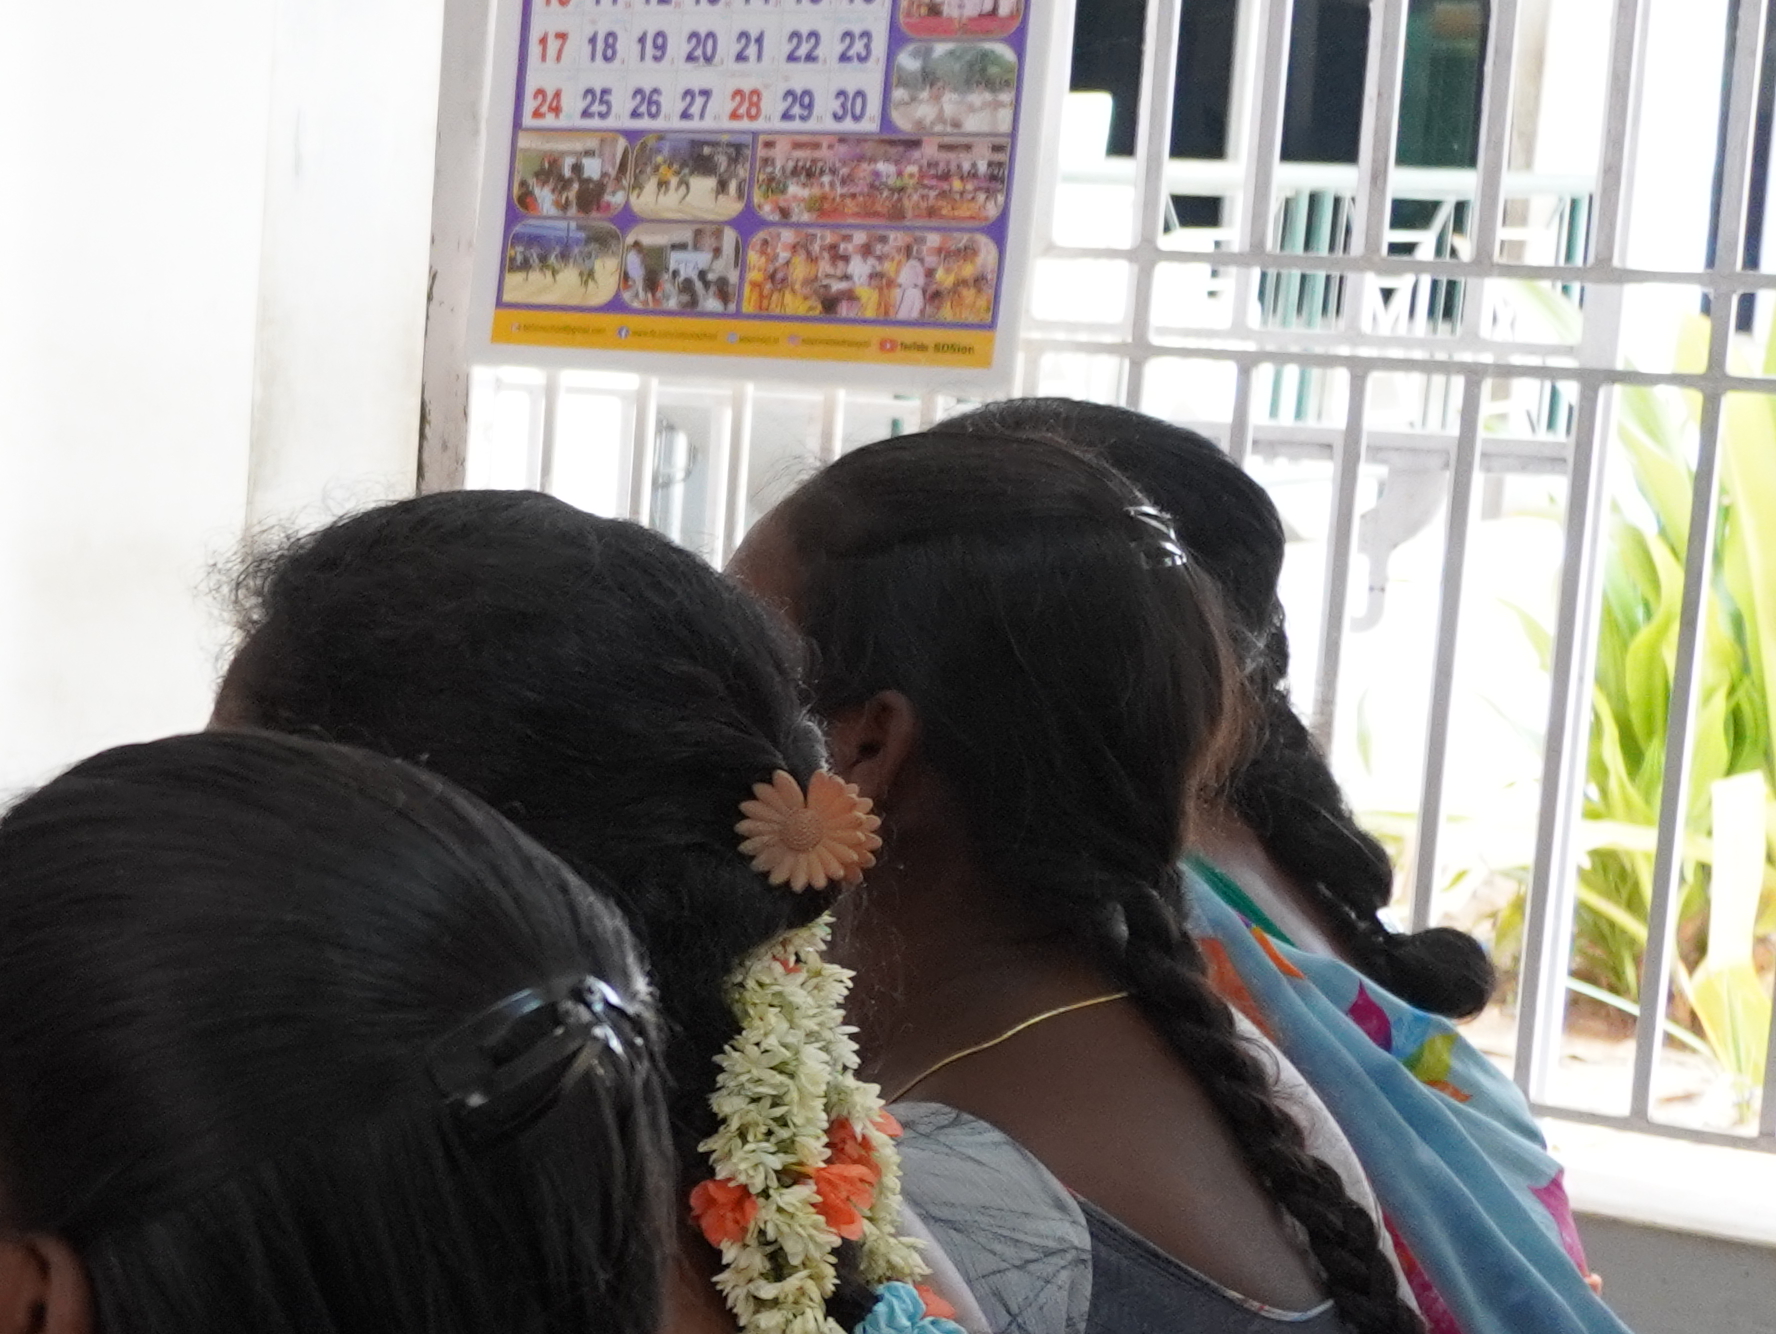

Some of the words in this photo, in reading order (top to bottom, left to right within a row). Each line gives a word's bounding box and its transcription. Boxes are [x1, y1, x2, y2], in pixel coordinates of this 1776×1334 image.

[538, 30, 570, 64] 17
[587, 30, 619, 64] 18
[637, 29, 669, 63] 19
[684, 30, 719, 65] 20
[734, 29, 766, 64] 21
[785, 29, 822, 64] 22
[837, 29, 874, 64] 23
[531, 87, 564, 120] 24
[580, 86, 613, 121] 25
[629, 86, 664, 121] 26
[679, 88, 714, 122] 27
[728, 88, 763, 122] 28
[779, 88, 816, 123] 29
[832, 88, 868, 124] 30
